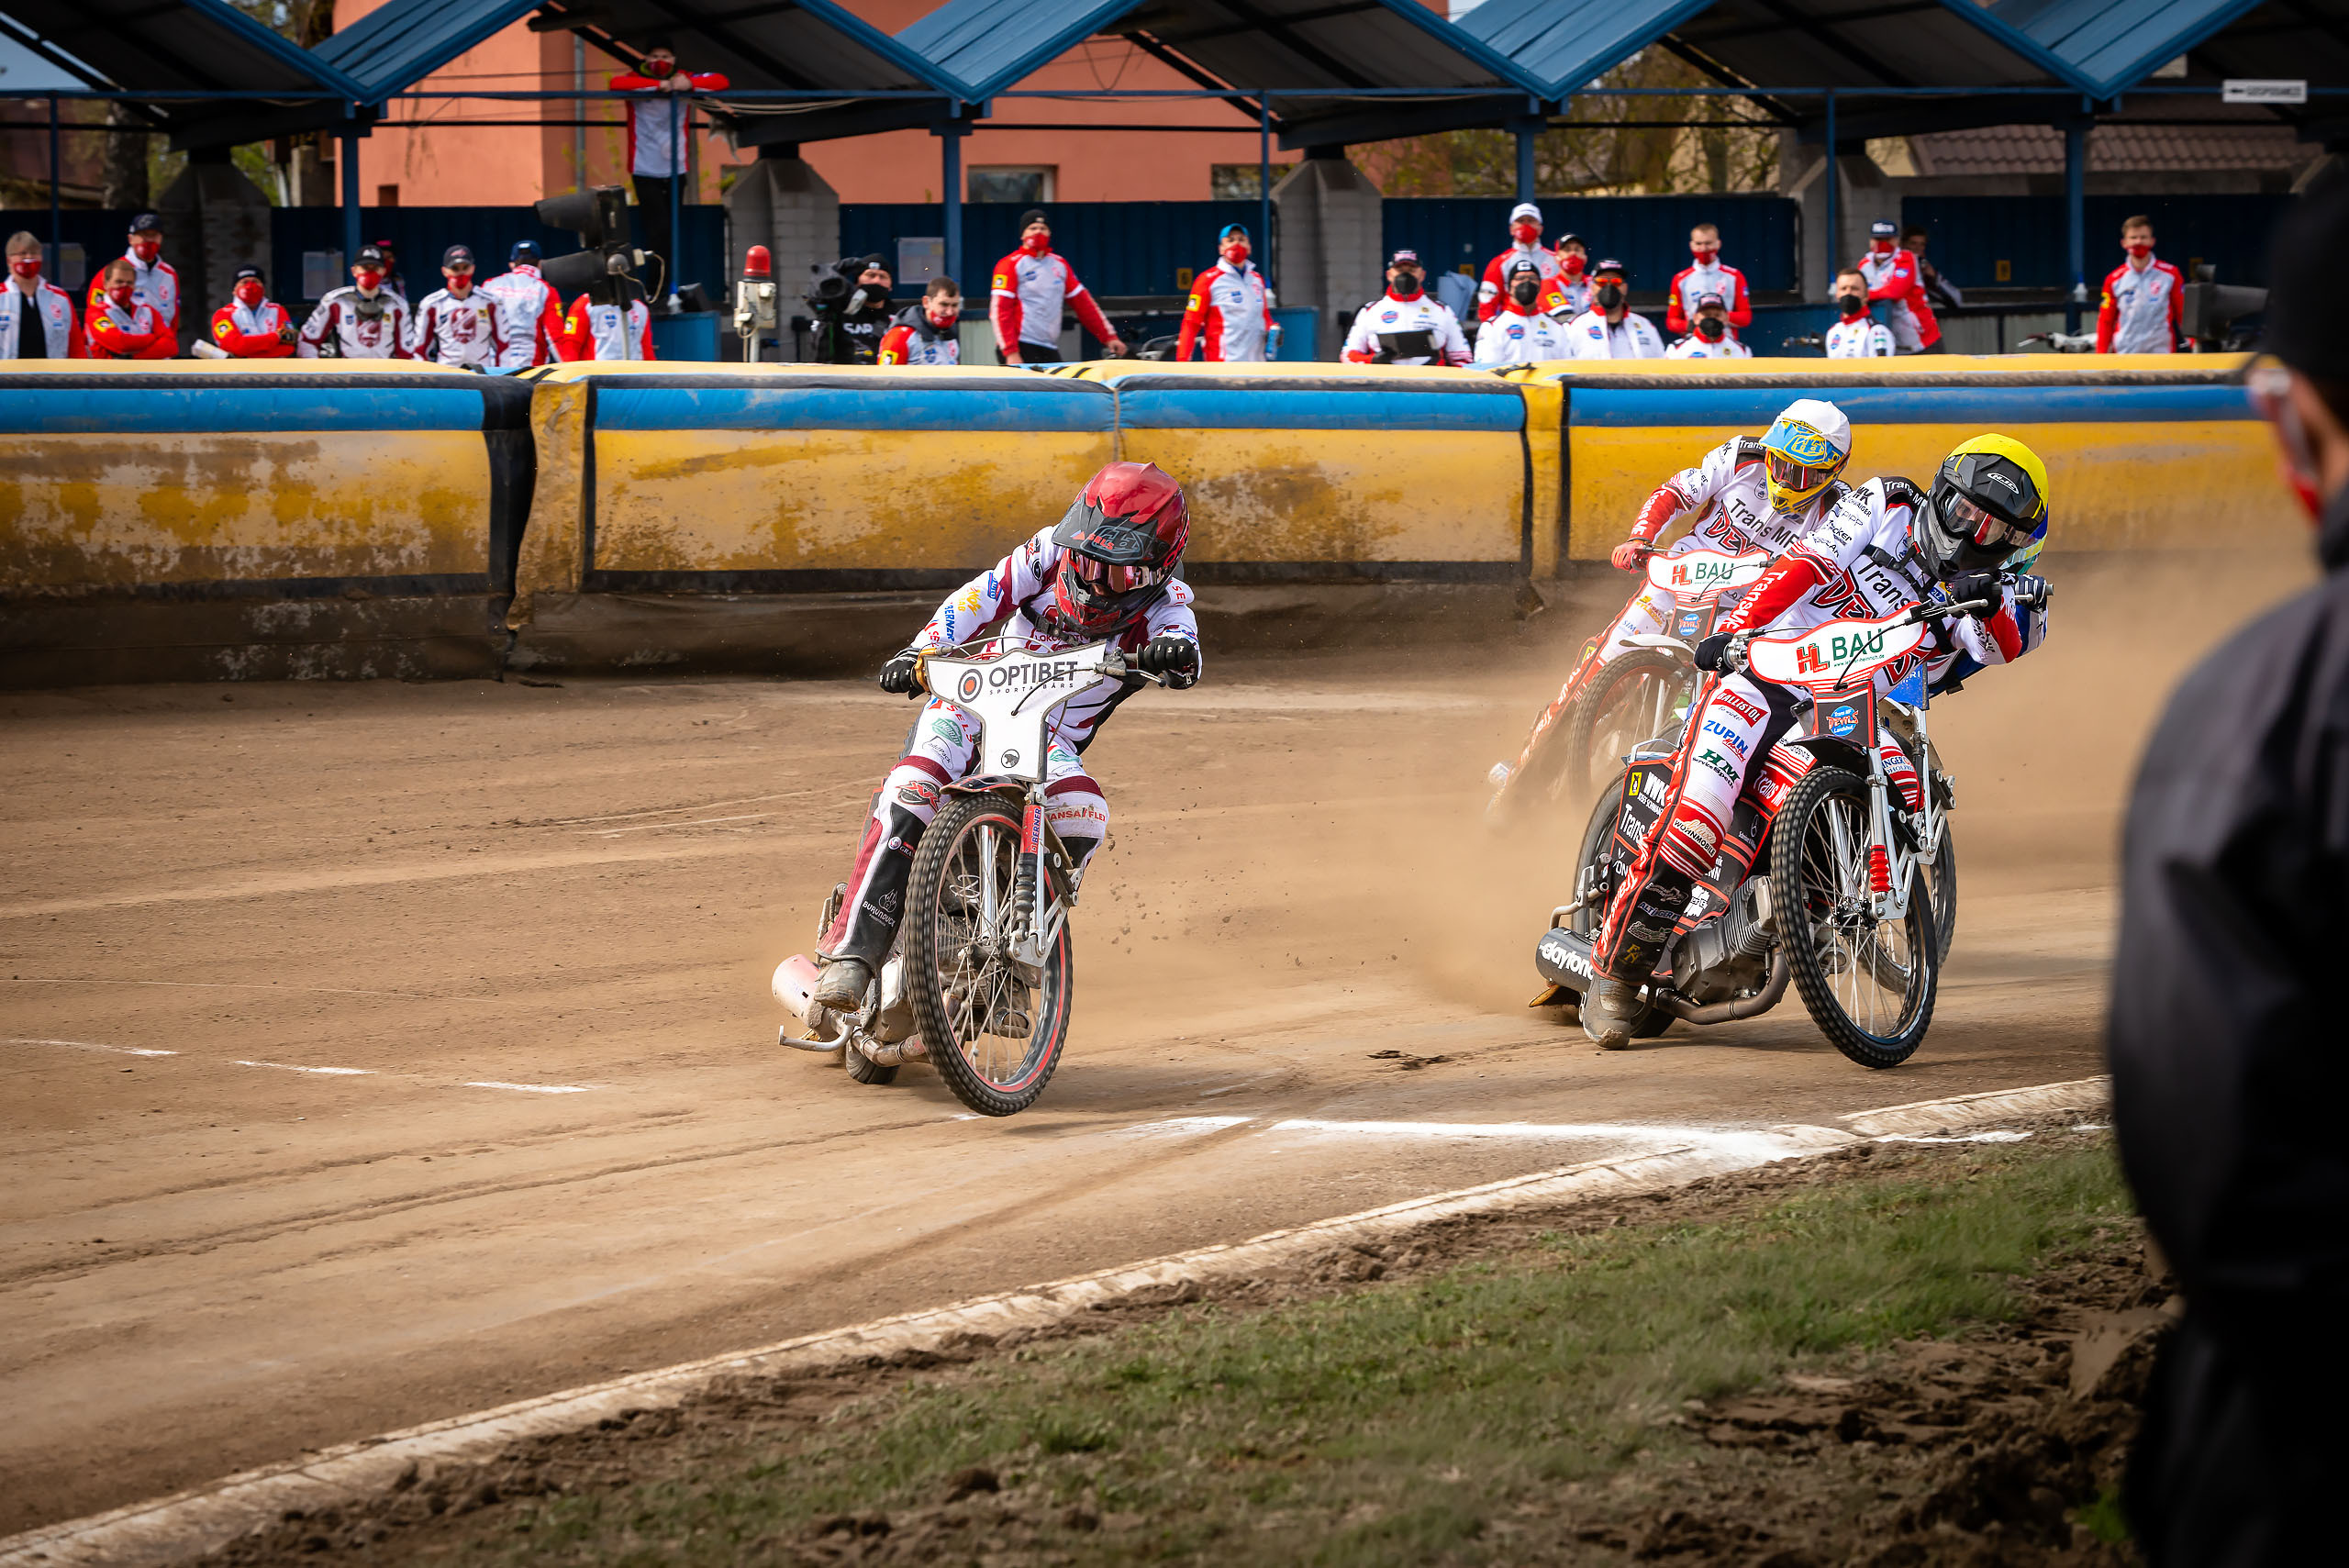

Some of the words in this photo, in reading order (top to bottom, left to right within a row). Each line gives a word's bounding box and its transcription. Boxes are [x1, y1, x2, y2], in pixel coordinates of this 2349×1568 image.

[1739, 439, 1764, 450] Trans
[1637, 489, 1667, 520] Trans
[1884, 481, 1915, 497] Trans
[1731, 498, 1773, 538] Trans
[1770, 526, 1800, 549] MF
[1086, 532, 1116, 550] SELS
[1695, 562, 1734, 580] BAU
[1857, 562, 1911, 611] Trans
[1739, 570, 1788, 610] Trans
[944, 605, 955, 642] BERNER
[1722, 607, 1751, 630] MF
[1831, 628, 1884, 662] BAU
[989, 661, 1079, 689] OPTIBET
[1716, 692, 1761, 722] BALLISTOL
[1826, 710, 1859, 730] DEVILS
[1703, 719, 1749, 755] ZUPIN
[1698, 749, 1741, 784] HM
[1753, 769, 1780, 800] Trans
[1031, 807, 1042, 846] BERNER
[1673, 818, 1716, 856] WOHNMOBILE
